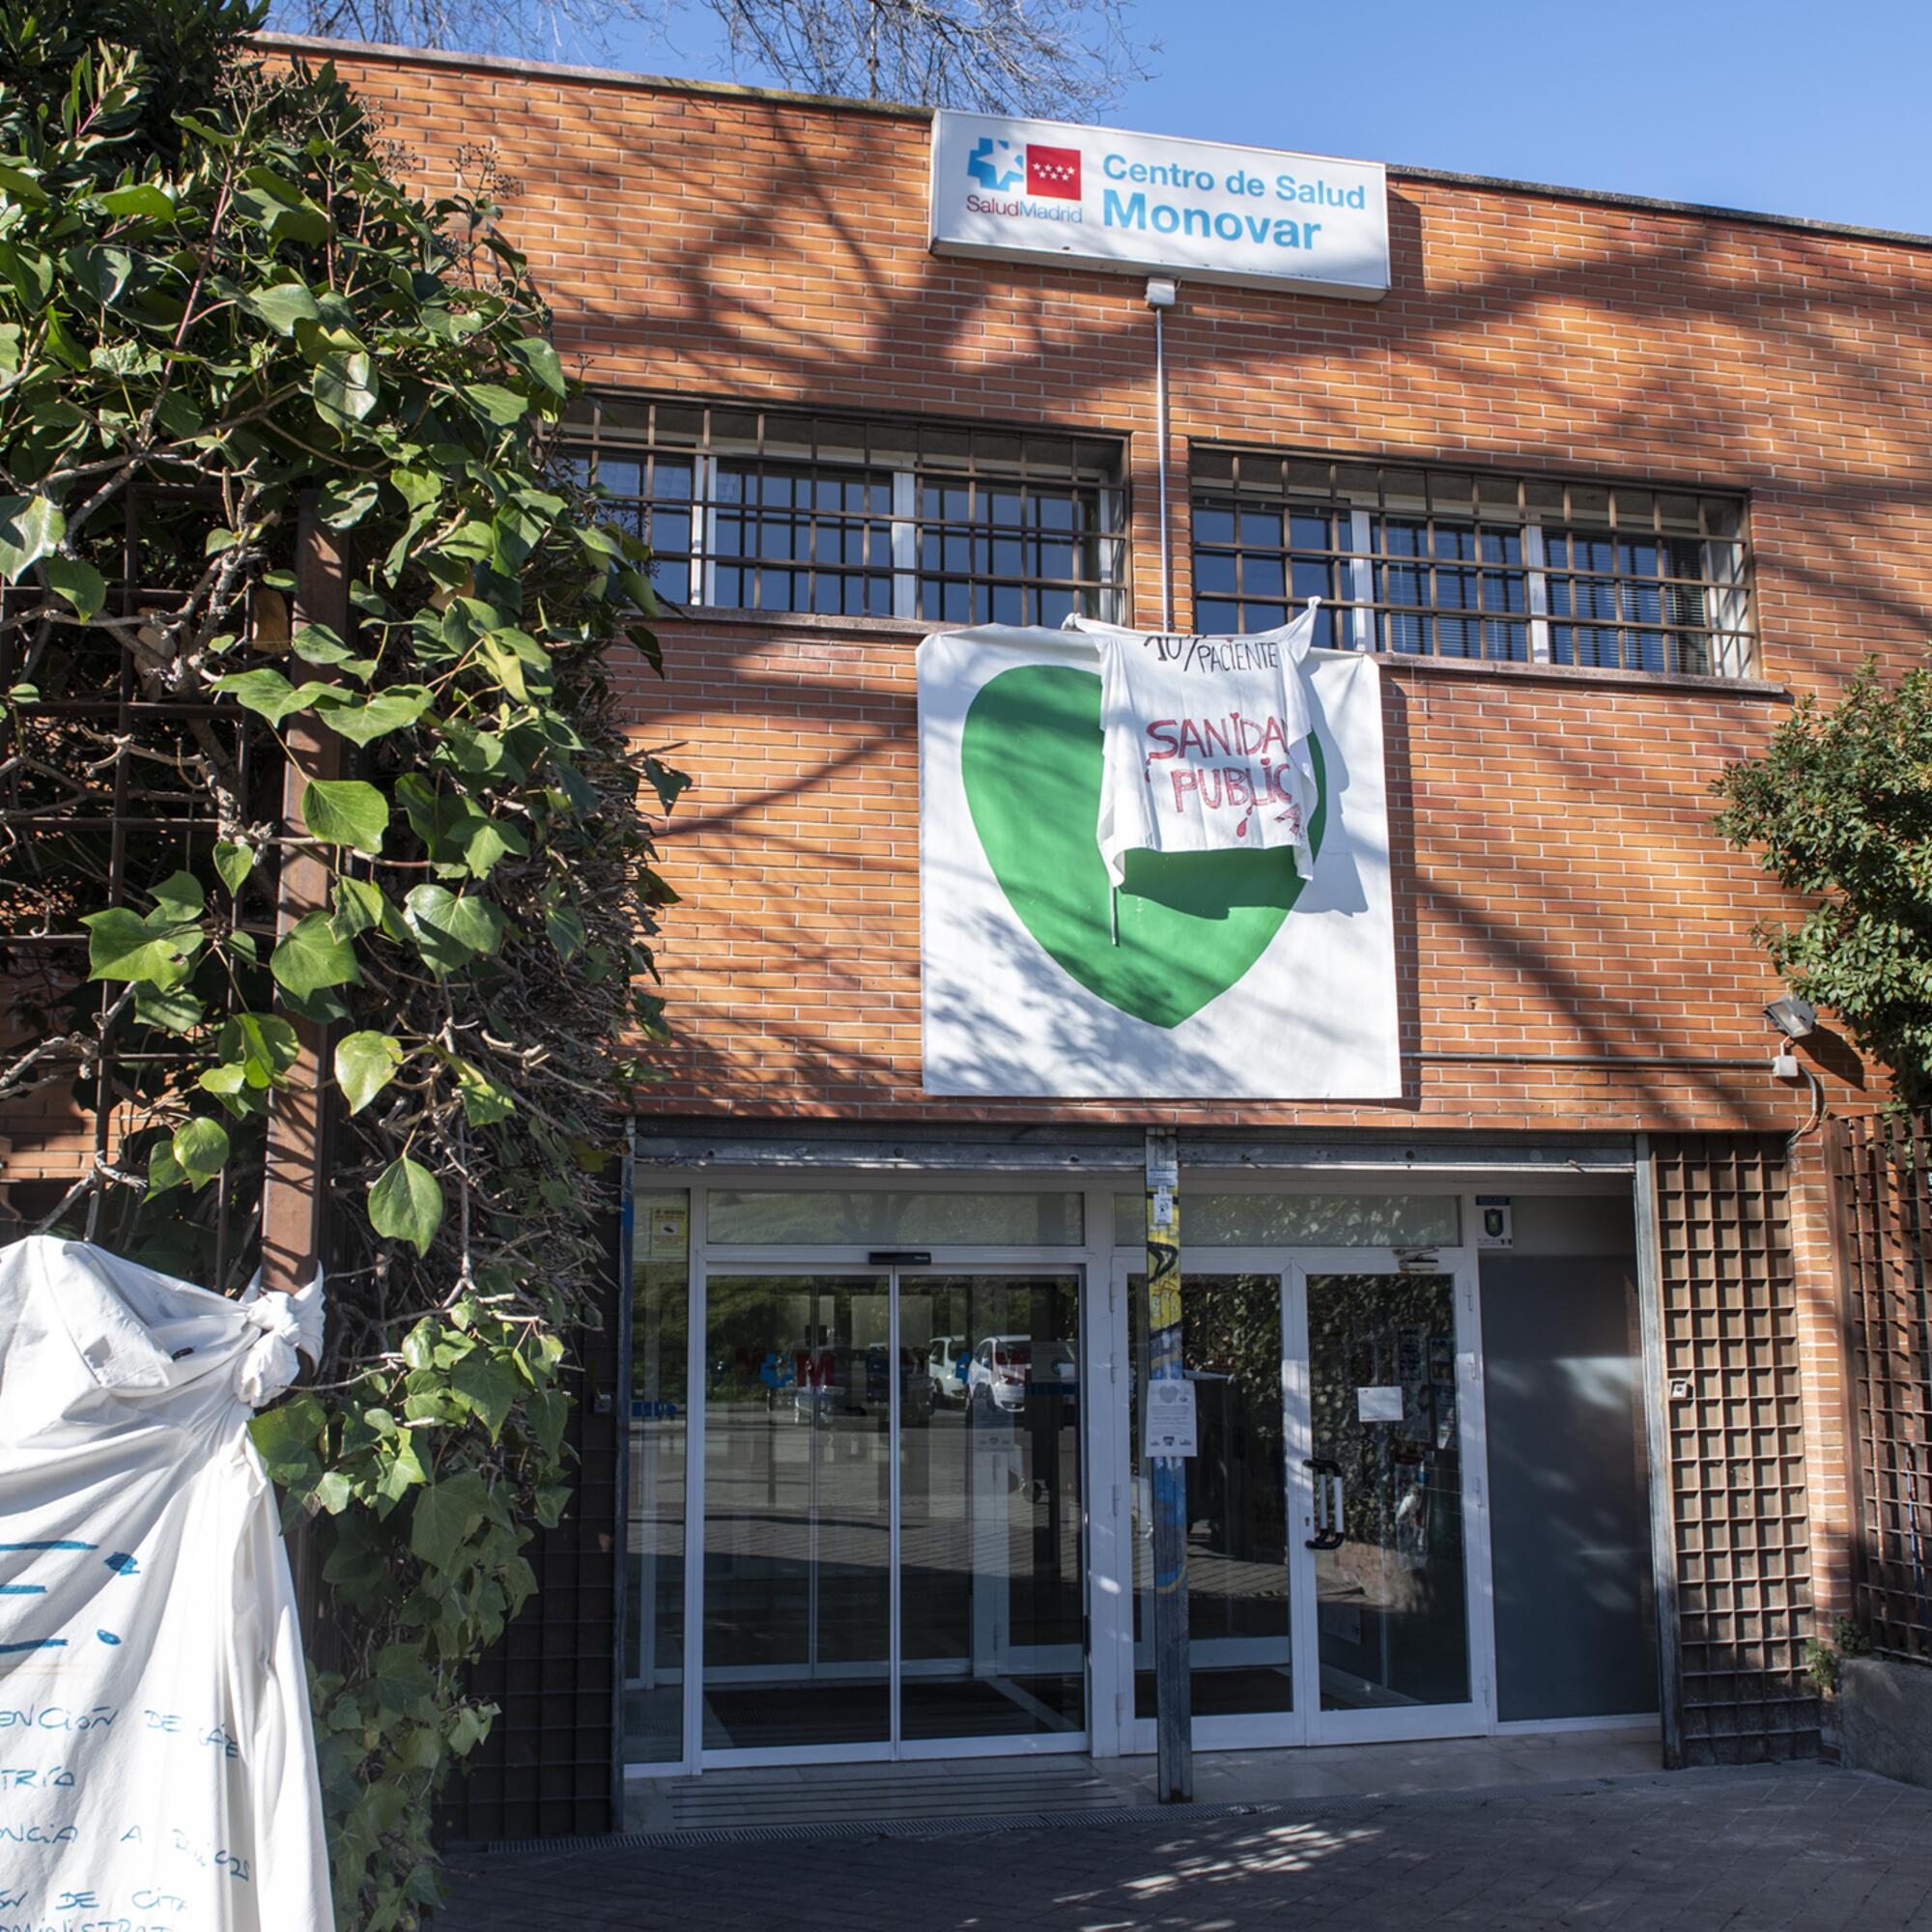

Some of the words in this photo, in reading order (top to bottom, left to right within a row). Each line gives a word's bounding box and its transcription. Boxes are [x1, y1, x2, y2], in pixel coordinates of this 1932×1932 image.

[1102, 154, 1215, 191] Centro
[1225, 170, 1265, 197] de
[1275, 175, 1366, 210] Salud
[966, 194, 1083, 223] SaludMadrid
[1102, 188, 1322, 250] Monovar
[1146, 712, 1290, 760] SANIDA
[144, 1709, 183, 1732] DE
[119, 1824, 143, 1844] A
[55, 1890, 99, 1910] DE
